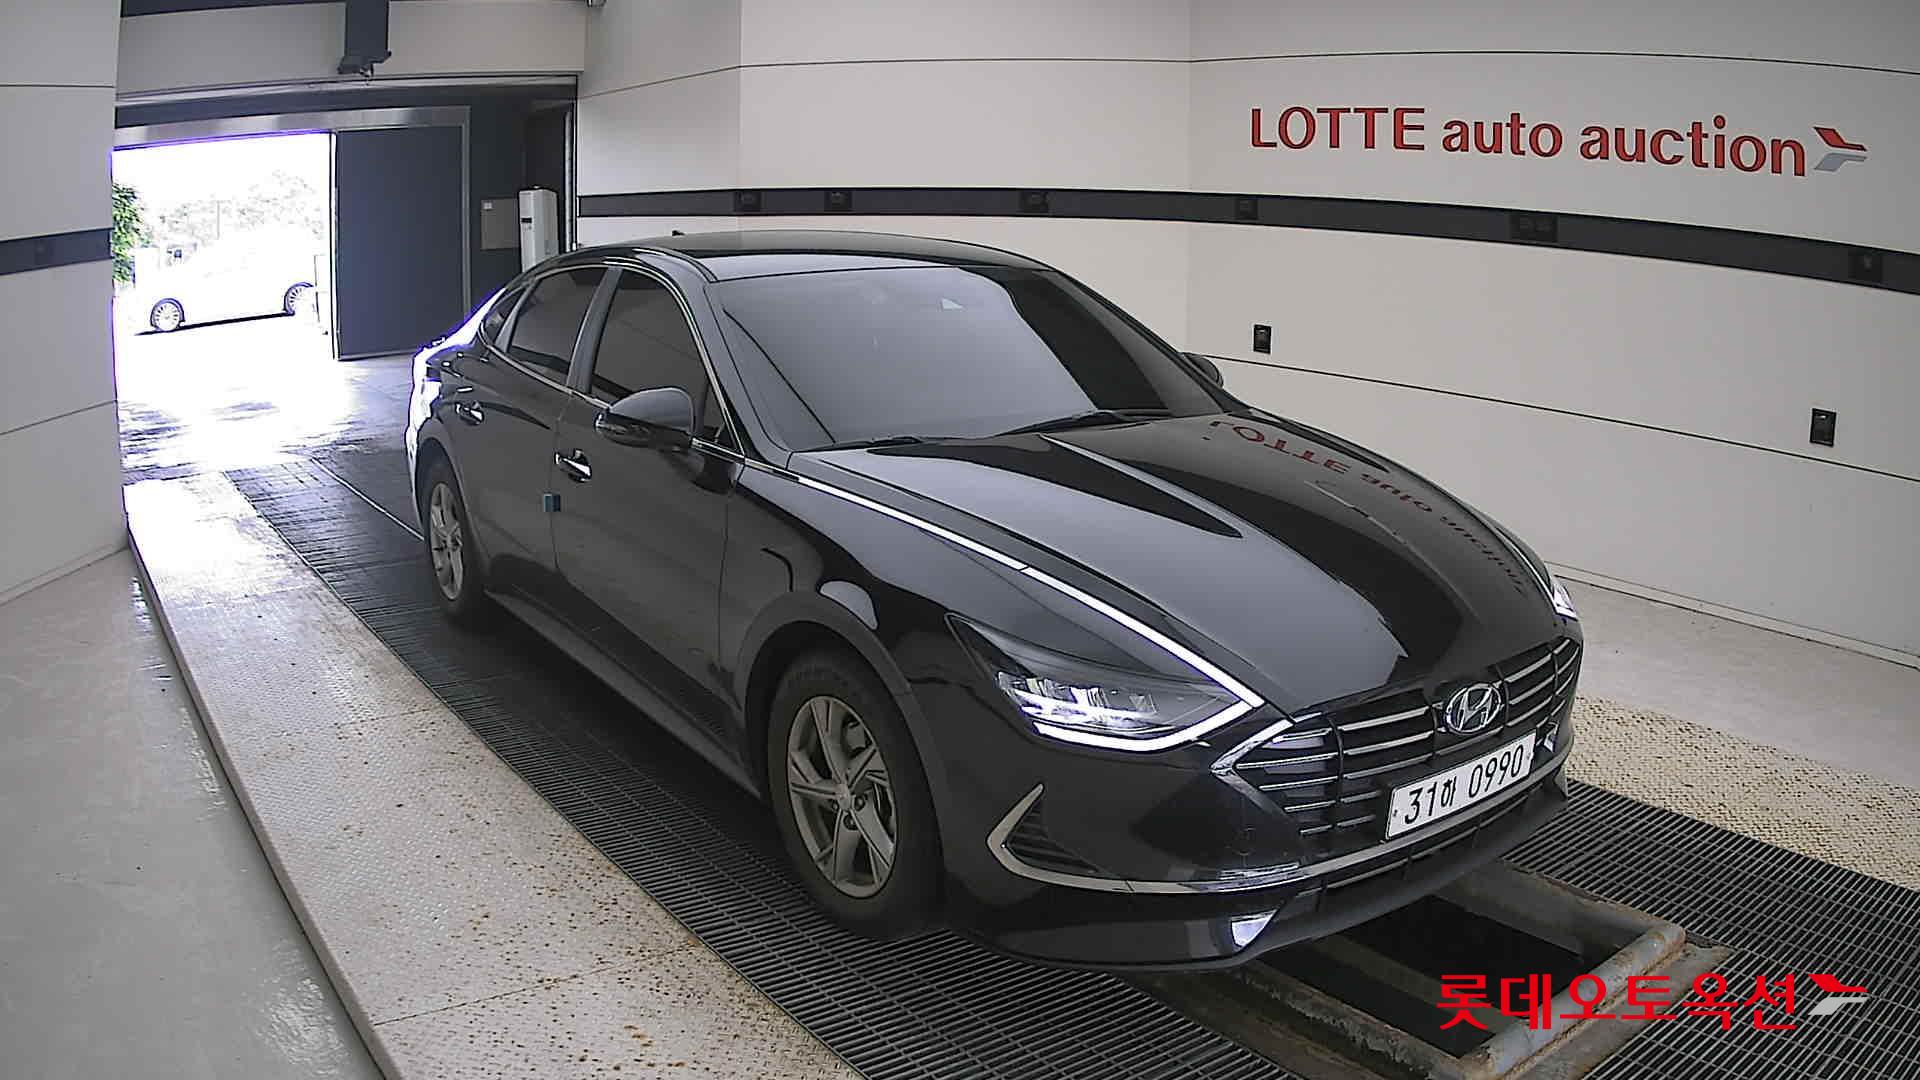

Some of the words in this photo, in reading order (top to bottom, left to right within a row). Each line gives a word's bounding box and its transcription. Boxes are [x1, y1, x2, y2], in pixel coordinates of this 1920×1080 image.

[1251, 107, 1426, 152] LOTTE
[1442, 113, 1563, 158] auto
[1580, 115, 1806, 177] auction
[1469, 745, 1524, 798] 0990
